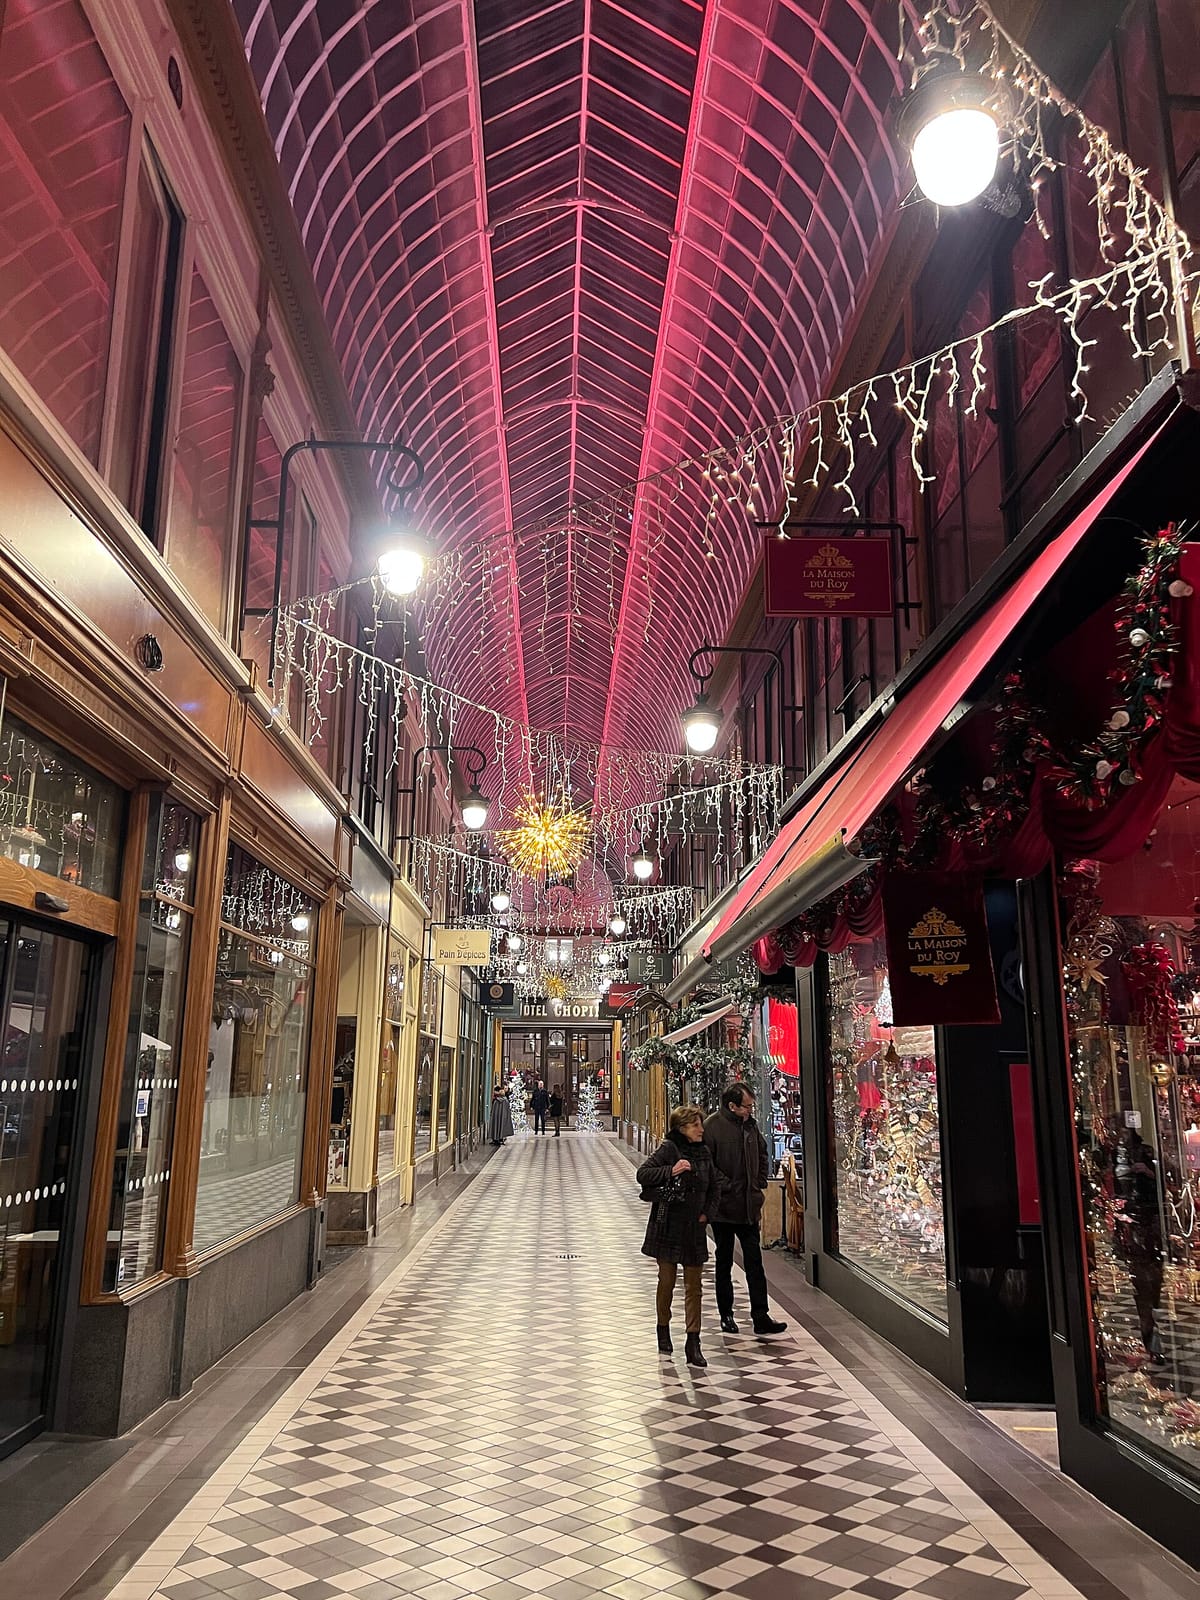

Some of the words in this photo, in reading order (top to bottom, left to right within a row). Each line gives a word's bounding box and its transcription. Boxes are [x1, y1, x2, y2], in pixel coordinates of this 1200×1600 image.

[803, 570, 814, 578] LA
[817, 569, 855, 578] MAISON
[908, 941, 922, 950] LA
[924, 938, 967, 950] MAISON
[439, 949, 455, 958] Pain
[917, 953, 932, 962] DU
